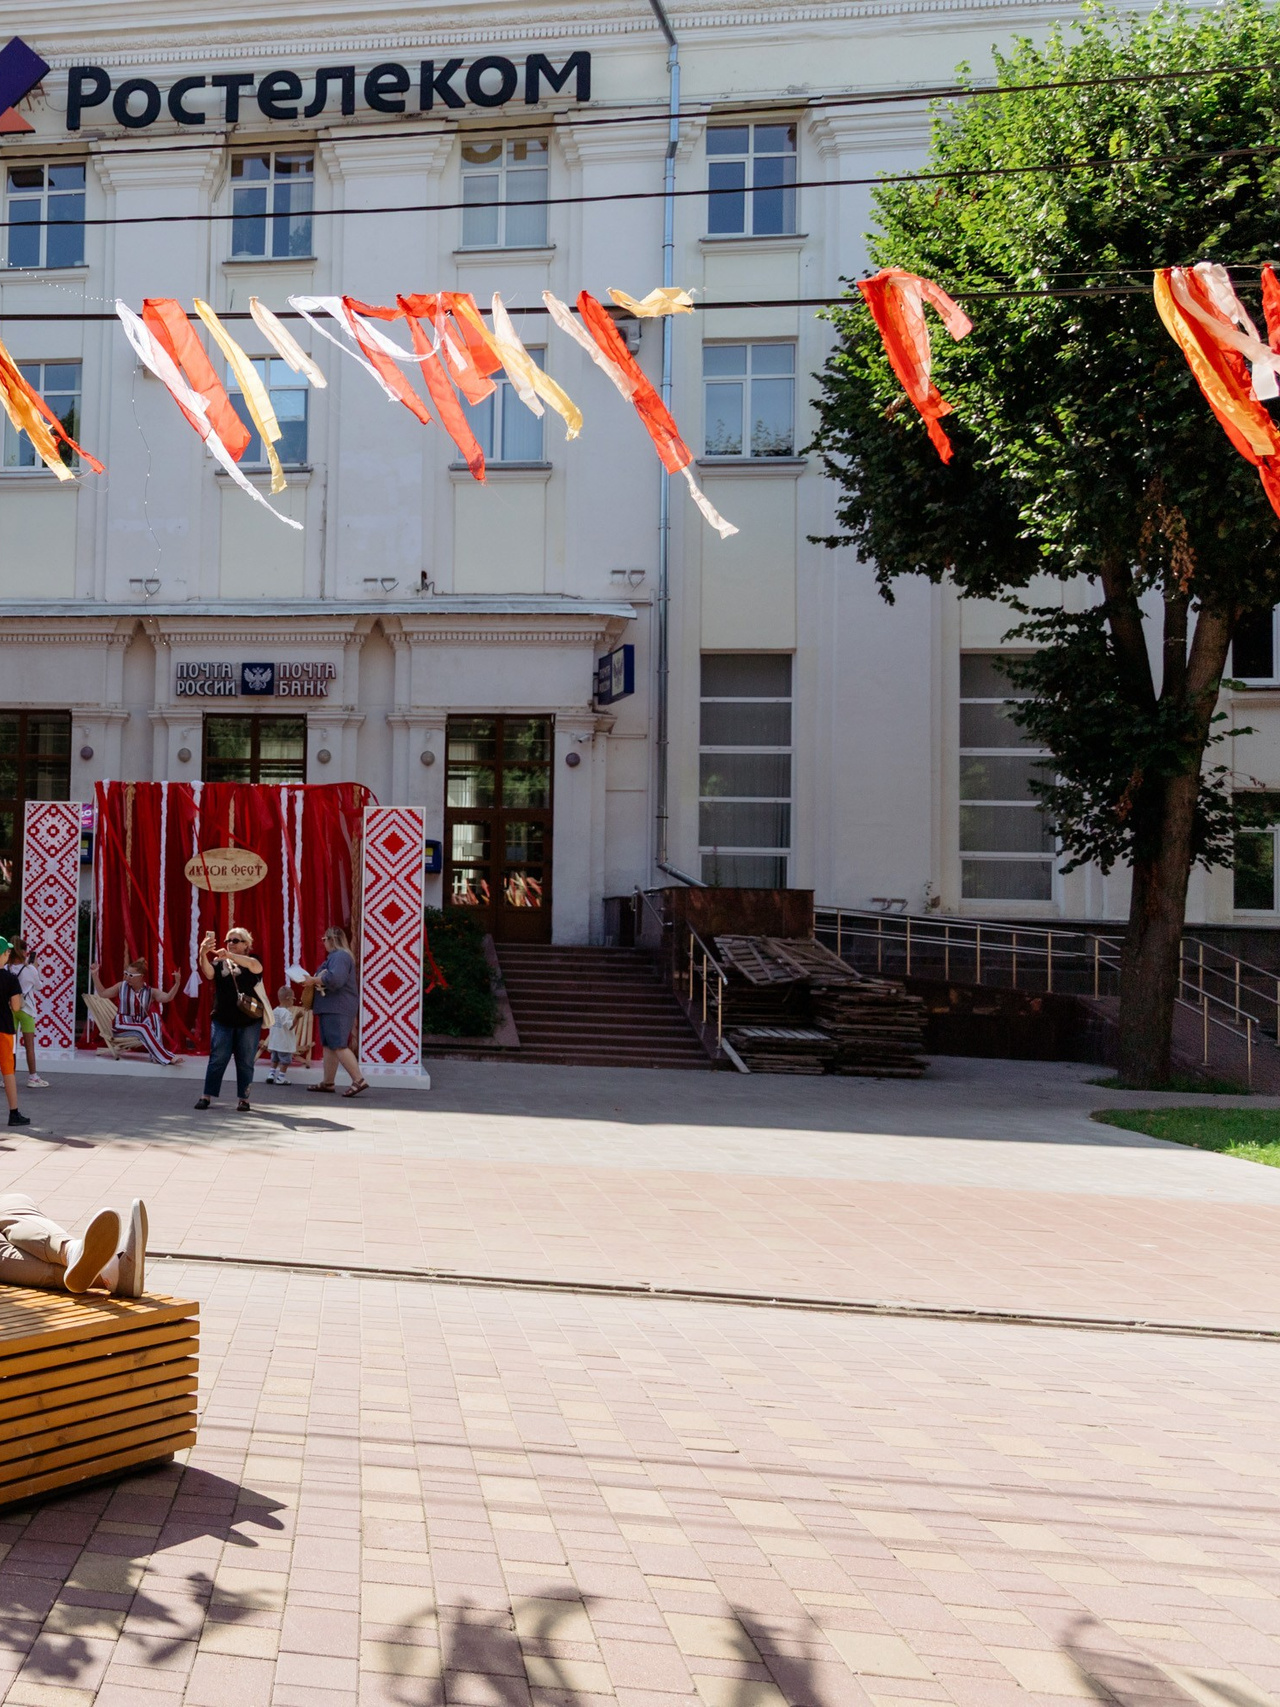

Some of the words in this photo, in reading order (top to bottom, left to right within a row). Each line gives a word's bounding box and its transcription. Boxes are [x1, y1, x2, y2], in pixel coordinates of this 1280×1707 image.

[66, 51, 592, 131] Ростелеком
[177, 662, 233, 679] ПОЧТА
[279, 662, 337, 679] ПОЧТА
[176, 680, 236, 696] РОССИИ
[279, 680, 328, 696] БАНК
[231, 864, 263, 877] ФЕСТ
